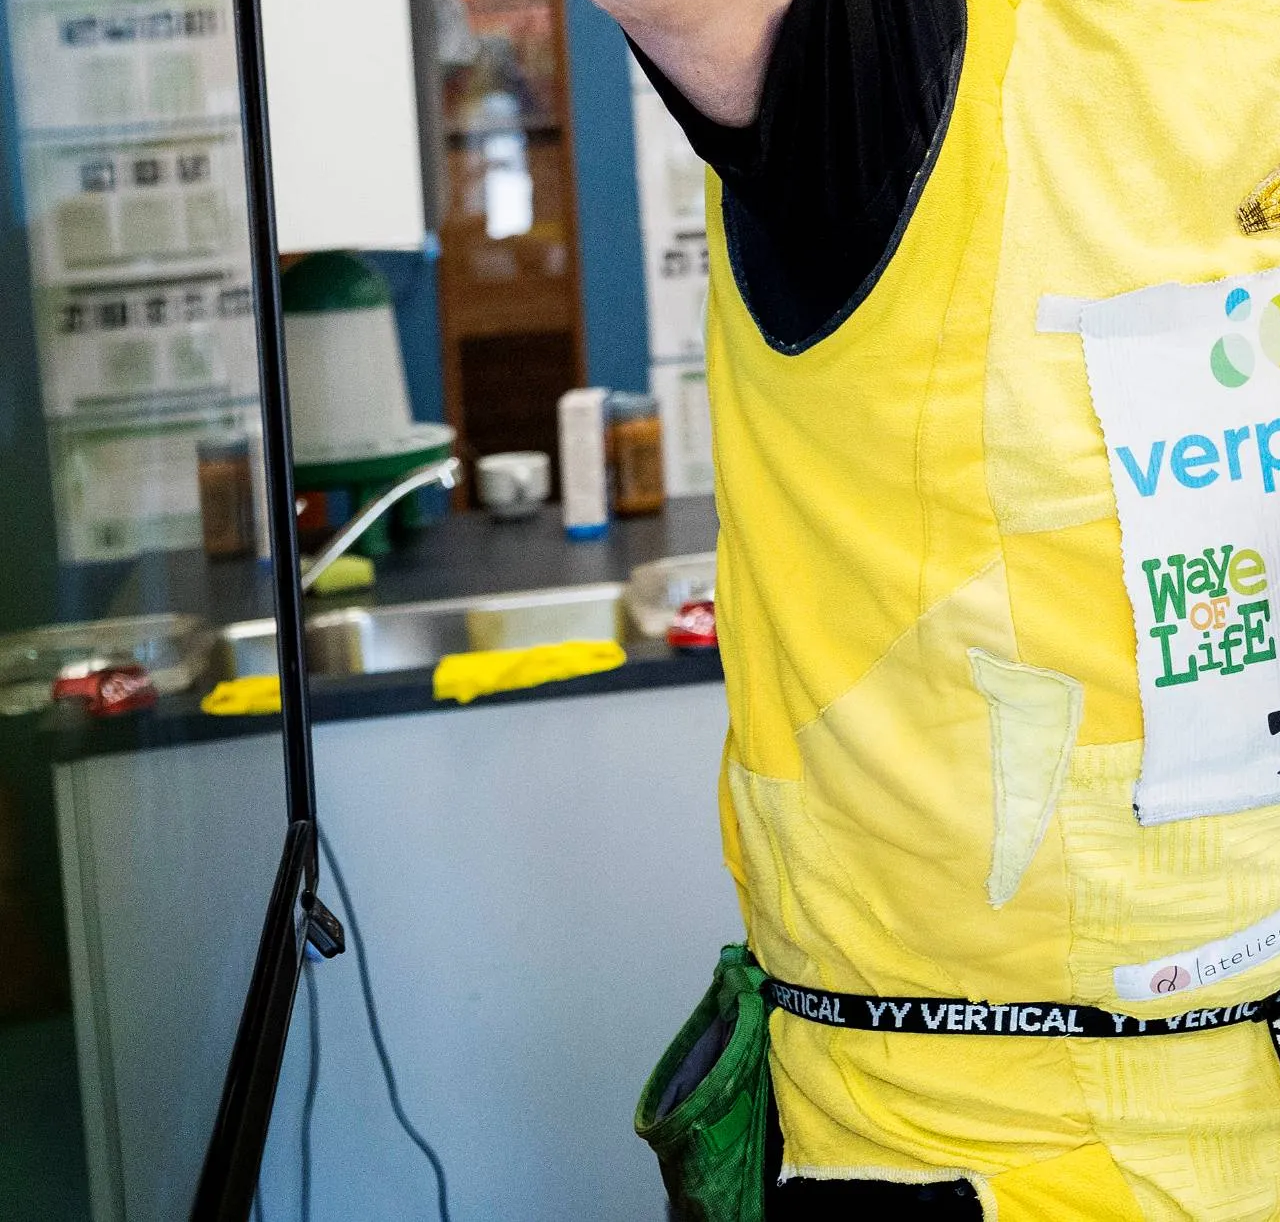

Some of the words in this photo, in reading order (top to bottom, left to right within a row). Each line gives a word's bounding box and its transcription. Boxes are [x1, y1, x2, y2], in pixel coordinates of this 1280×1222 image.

[772, 983, 846, 1023] ERTICAL
[865, 999, 912, 1028] YY
[920, 1003, 1084, 1034] VERTICAL
[1165, 1001, 1258, 1030] VERTIC
